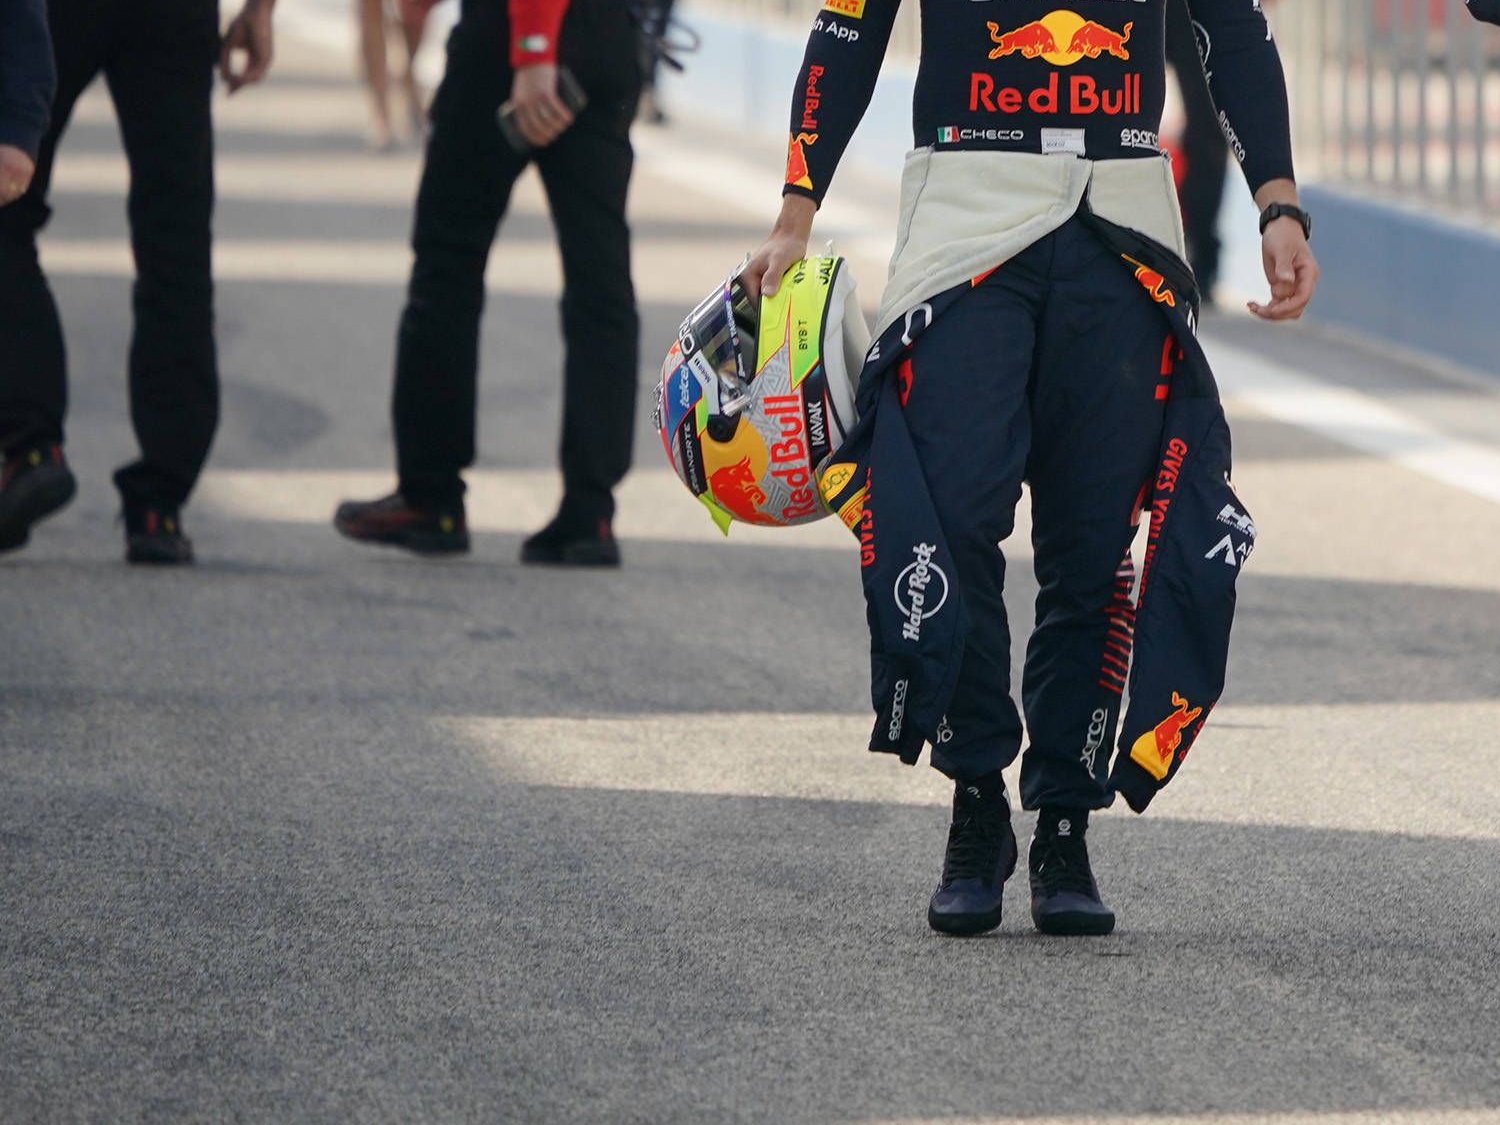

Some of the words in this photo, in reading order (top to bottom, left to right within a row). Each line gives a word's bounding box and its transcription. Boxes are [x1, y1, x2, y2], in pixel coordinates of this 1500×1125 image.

[826, 21, 860, 43] App
[806, 64, 825, 98] Red
[968, 72, 1060, 114] Red
[1069, 73, 1141, 115] Bull
[801, 98, 820, 129] Bull
[960, 129, 1024, 141] CHECO
[763, 394, 806, 465] Bull
[807, 400, 825, 447] KAVAK
[1154, 437, 1189, 494] GIVES
[771, 467, 817, 521] Red
[860, 509, 876, 567] GIVES
[908, 541, 937, 591] Rock
[902, 589, 925, 642] Hard
[888, 679, 909, 742] sparco
